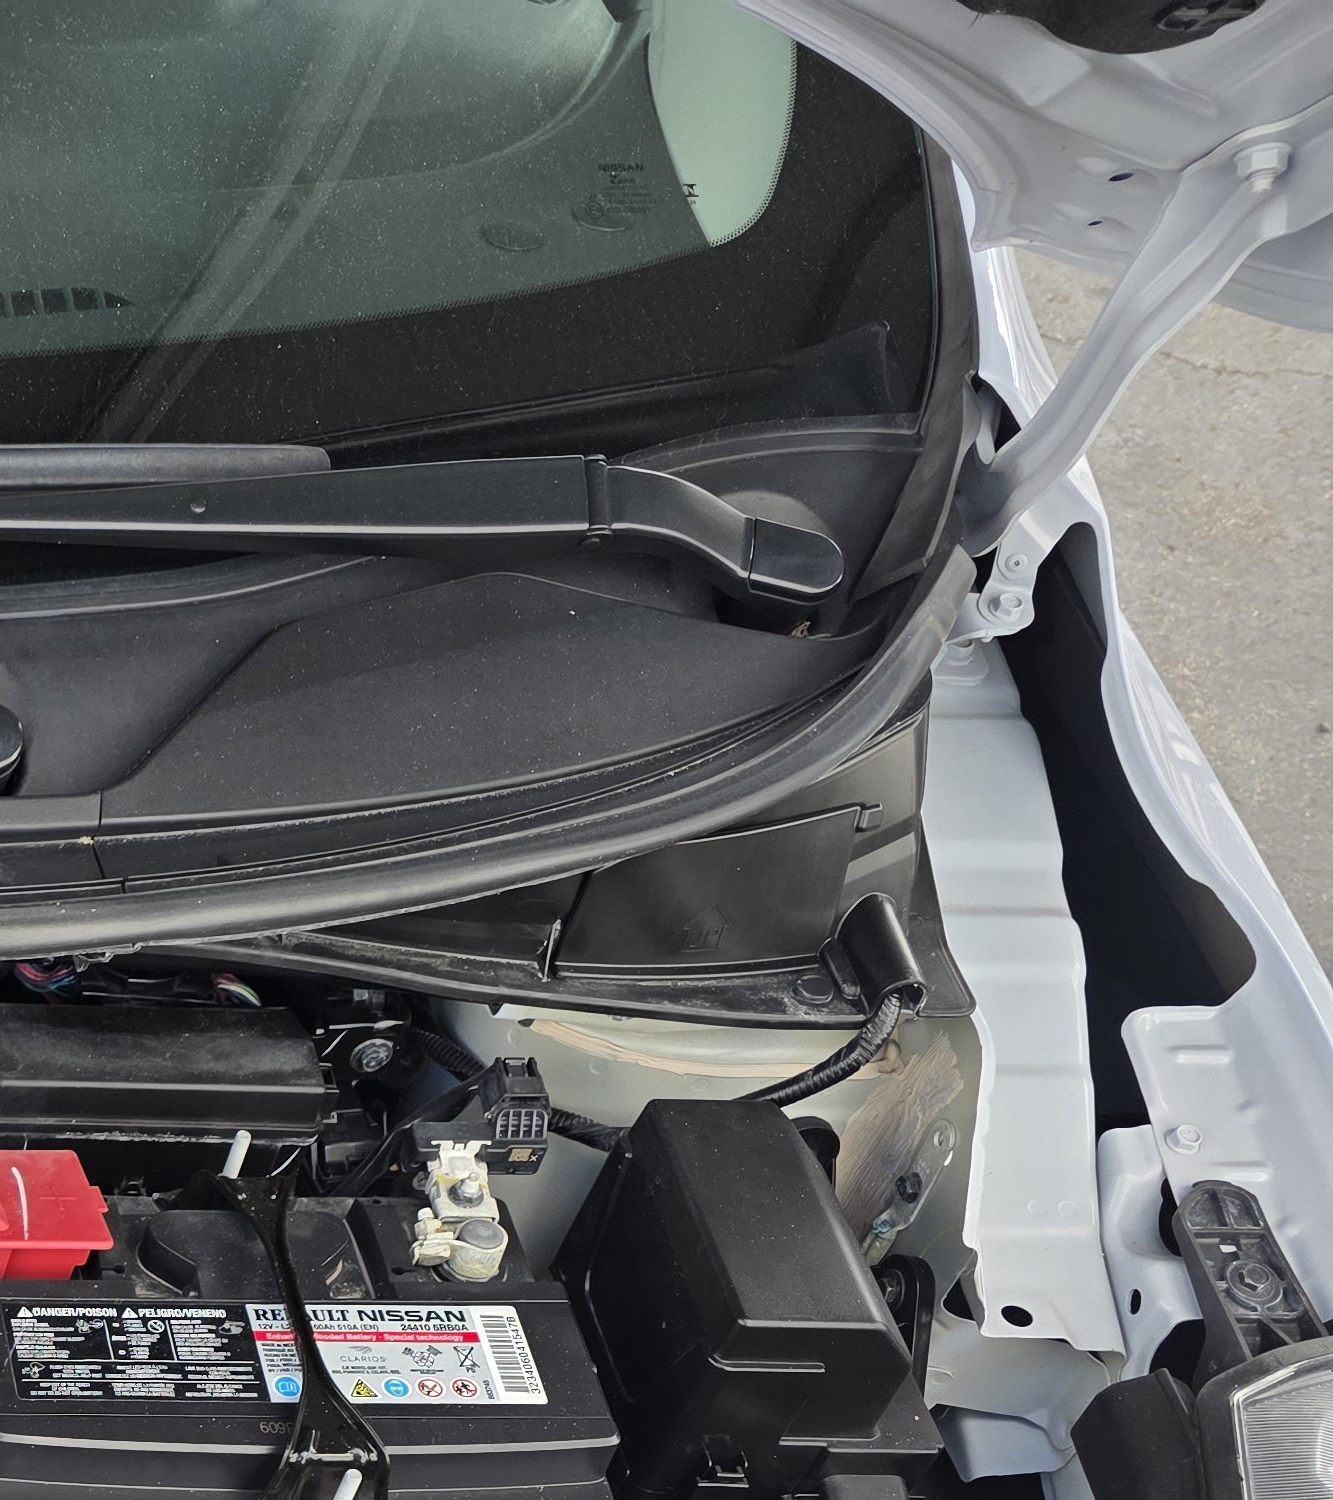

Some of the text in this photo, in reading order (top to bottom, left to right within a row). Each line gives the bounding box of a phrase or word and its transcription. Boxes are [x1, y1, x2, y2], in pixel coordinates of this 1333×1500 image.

[32, 1308, 118, 1317] DANGER/POISON
[137, 1308, 227, 1318] PELIGRO/VENENO
[252, 1308, 467, 1322] REULT NISSAN
[266, 1332, 294, 1340] Enhan
[313, 1332, 345, 1340] looded
[347, 1333, 377, 1342] Battery
[383, 1333, 415, 1342] Special
[416, 1334, 464, 1342] technology
[339, 1355, 386, 1363] CLARIOS
